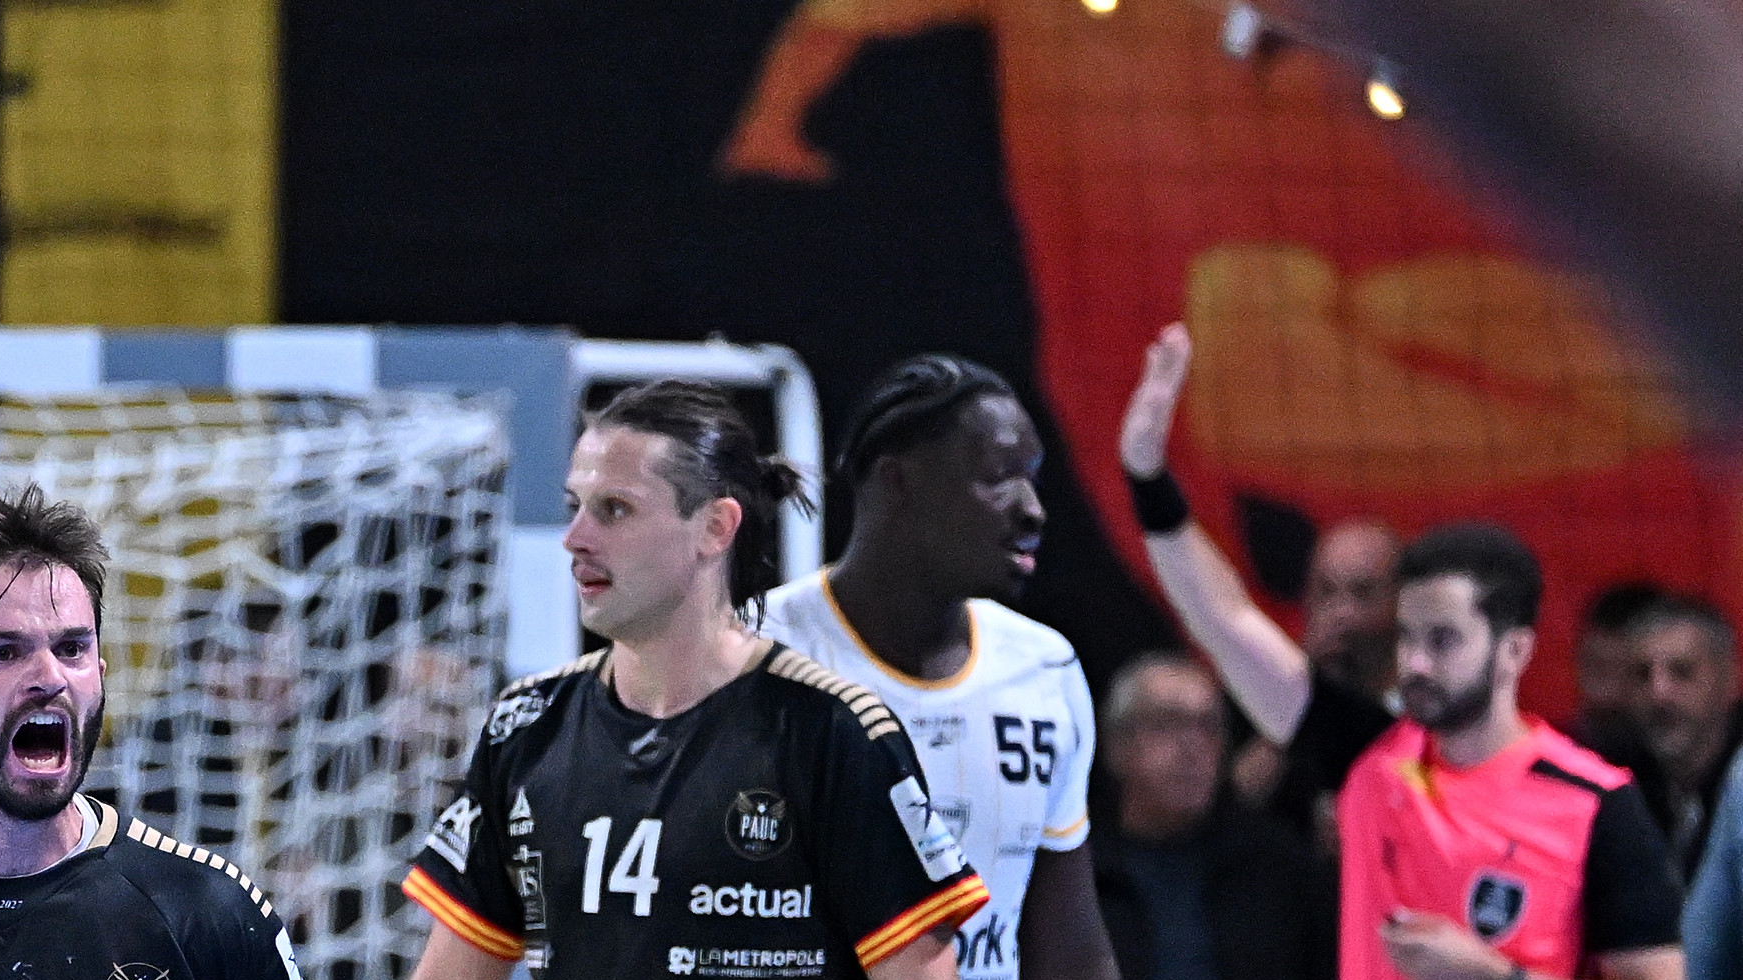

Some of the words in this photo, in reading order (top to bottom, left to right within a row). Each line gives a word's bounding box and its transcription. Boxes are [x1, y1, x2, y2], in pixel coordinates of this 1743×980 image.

[993, 714, 1056, 785] 55
[740, 814, 780, 841] PAUC
[582, 816, 662, 916] 14
[690, 882, 812, 918] actual
